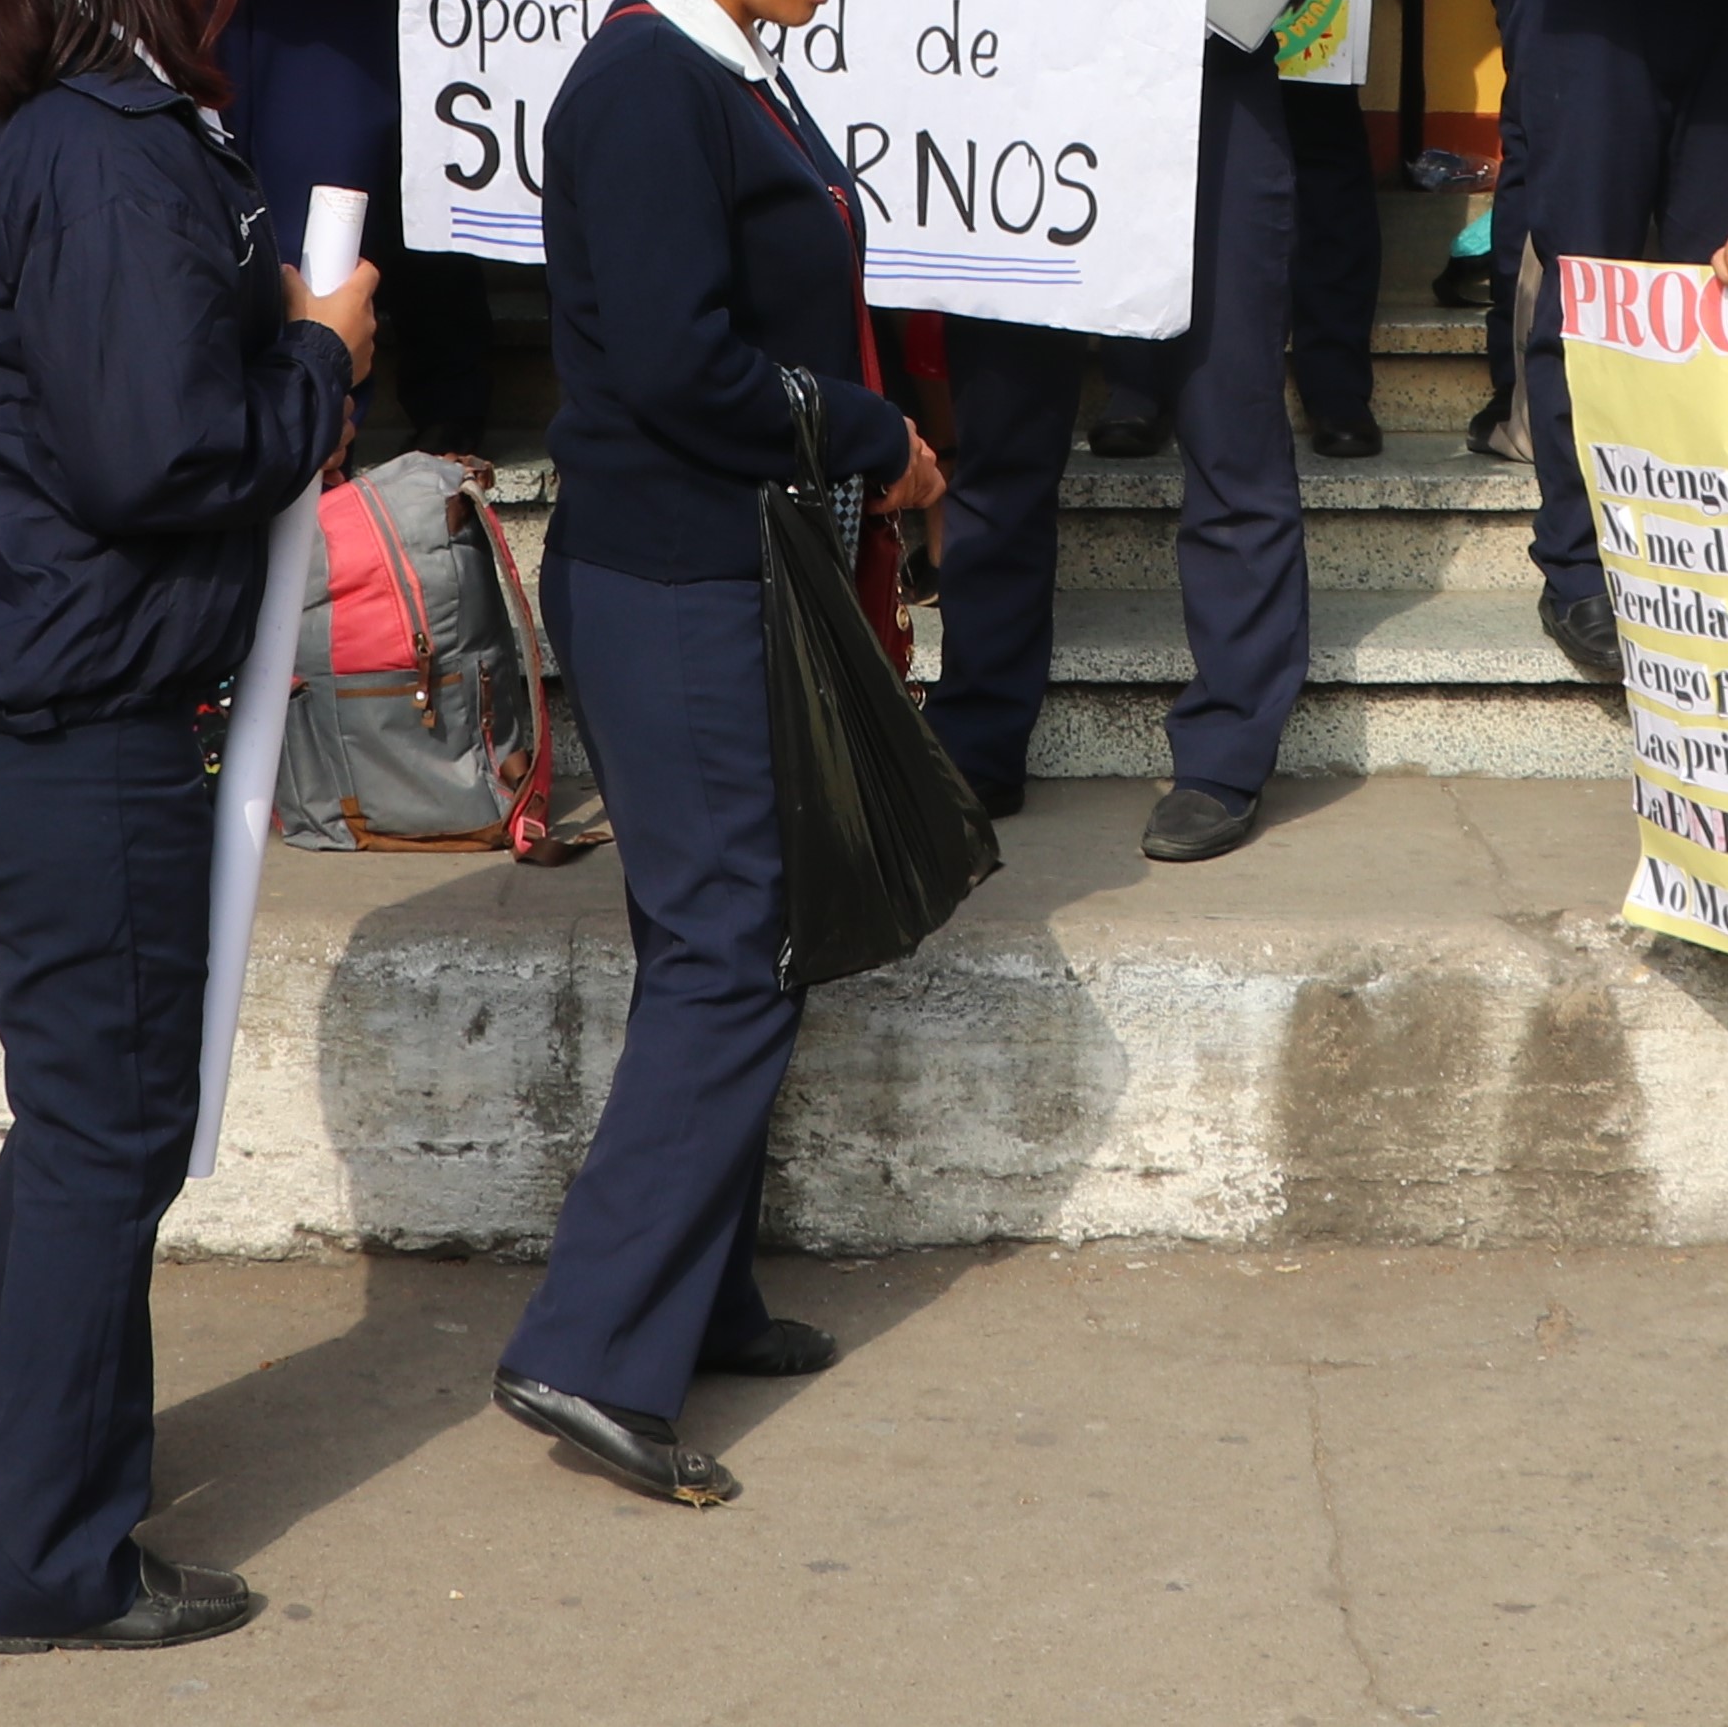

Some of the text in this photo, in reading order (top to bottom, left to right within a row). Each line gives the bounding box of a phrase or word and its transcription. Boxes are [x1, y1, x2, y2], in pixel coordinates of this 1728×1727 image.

[916, 0, 1000, 79] de
[1593, 445, 1638, 495] No
[1646, 530, 1697, 569] me
